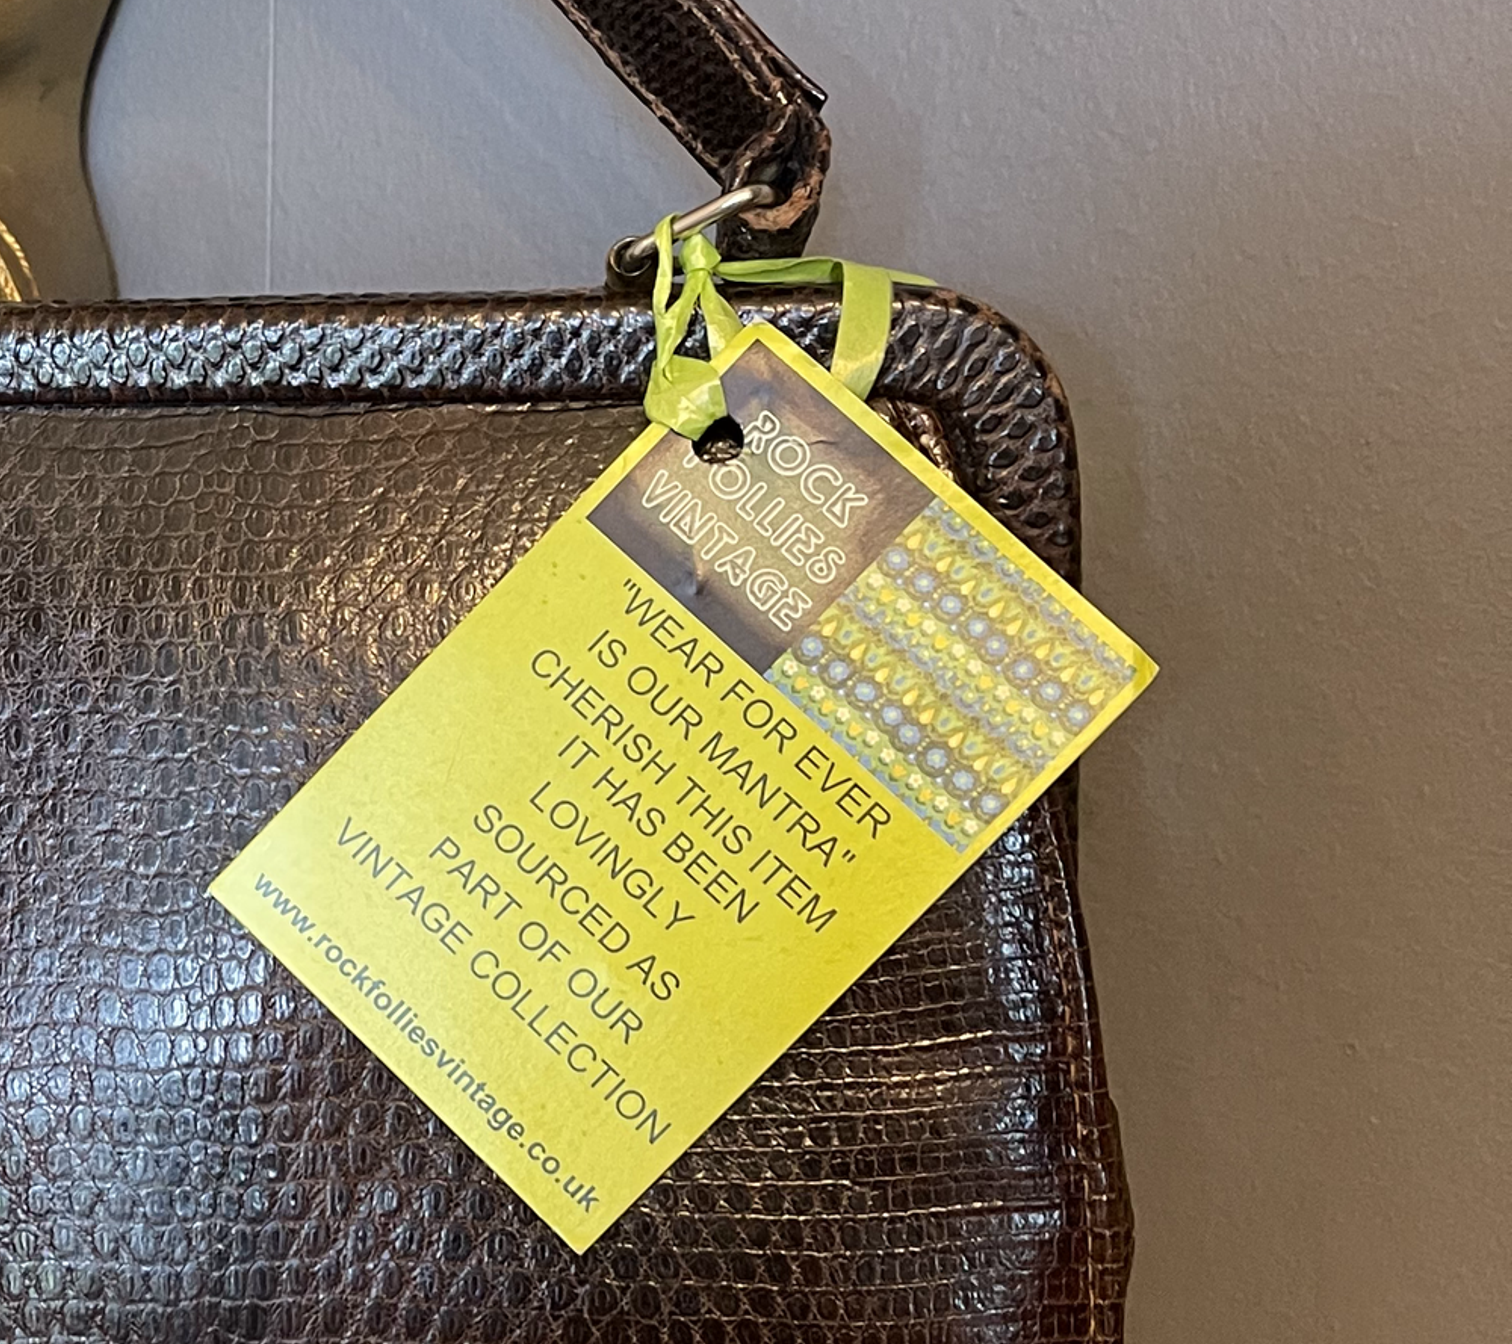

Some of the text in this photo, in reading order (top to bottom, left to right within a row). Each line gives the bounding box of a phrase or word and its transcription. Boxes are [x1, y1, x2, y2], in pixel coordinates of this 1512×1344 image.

[641, 470, 813, 631] VINTAGE
[683, 450, 846, 584] OLLIES
[744, 409, 868, 528] ROCK
[530, 650, 838, 933] CHERISH THIS ITEM
[587, 630, 856, 868] IS OUR MANTRA"
[622, 578, 892, 839] "WEAR FOR EVER
[473, 804, 681, 1001] SOURCED AS
[529, 781, 696, 931] LOVINGLY
[558, 734, 761, 924] IT HAS BEEN
[338, 816, 672, 1145] VINTAGE COLLECTION
[428, 836, 644, 1045] PART OF OUR
[254, 873, 601, 1213] www.rockfolliesvintage.co.uk
